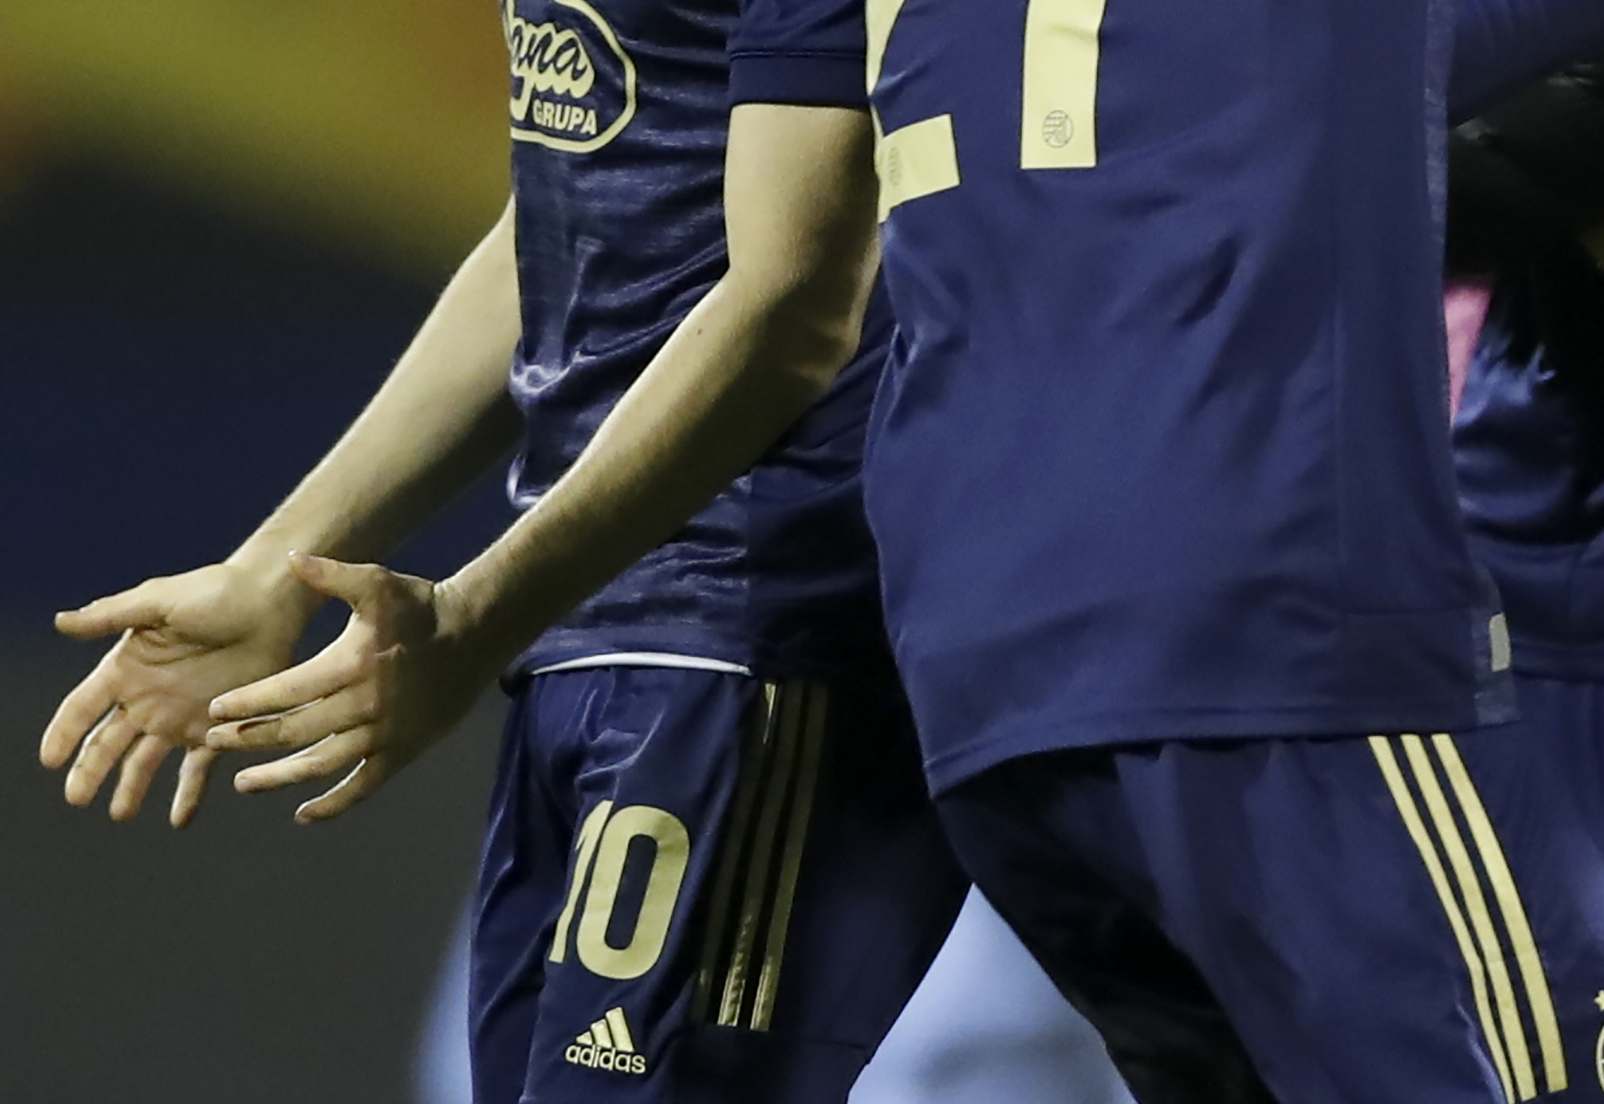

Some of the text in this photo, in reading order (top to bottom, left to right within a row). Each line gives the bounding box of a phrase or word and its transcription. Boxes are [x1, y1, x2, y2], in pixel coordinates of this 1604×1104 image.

[533, 99, 598, 136] GRUPA
[549, 800, 690, 980] 10
[565, 1044, 647, 1074] adidas
